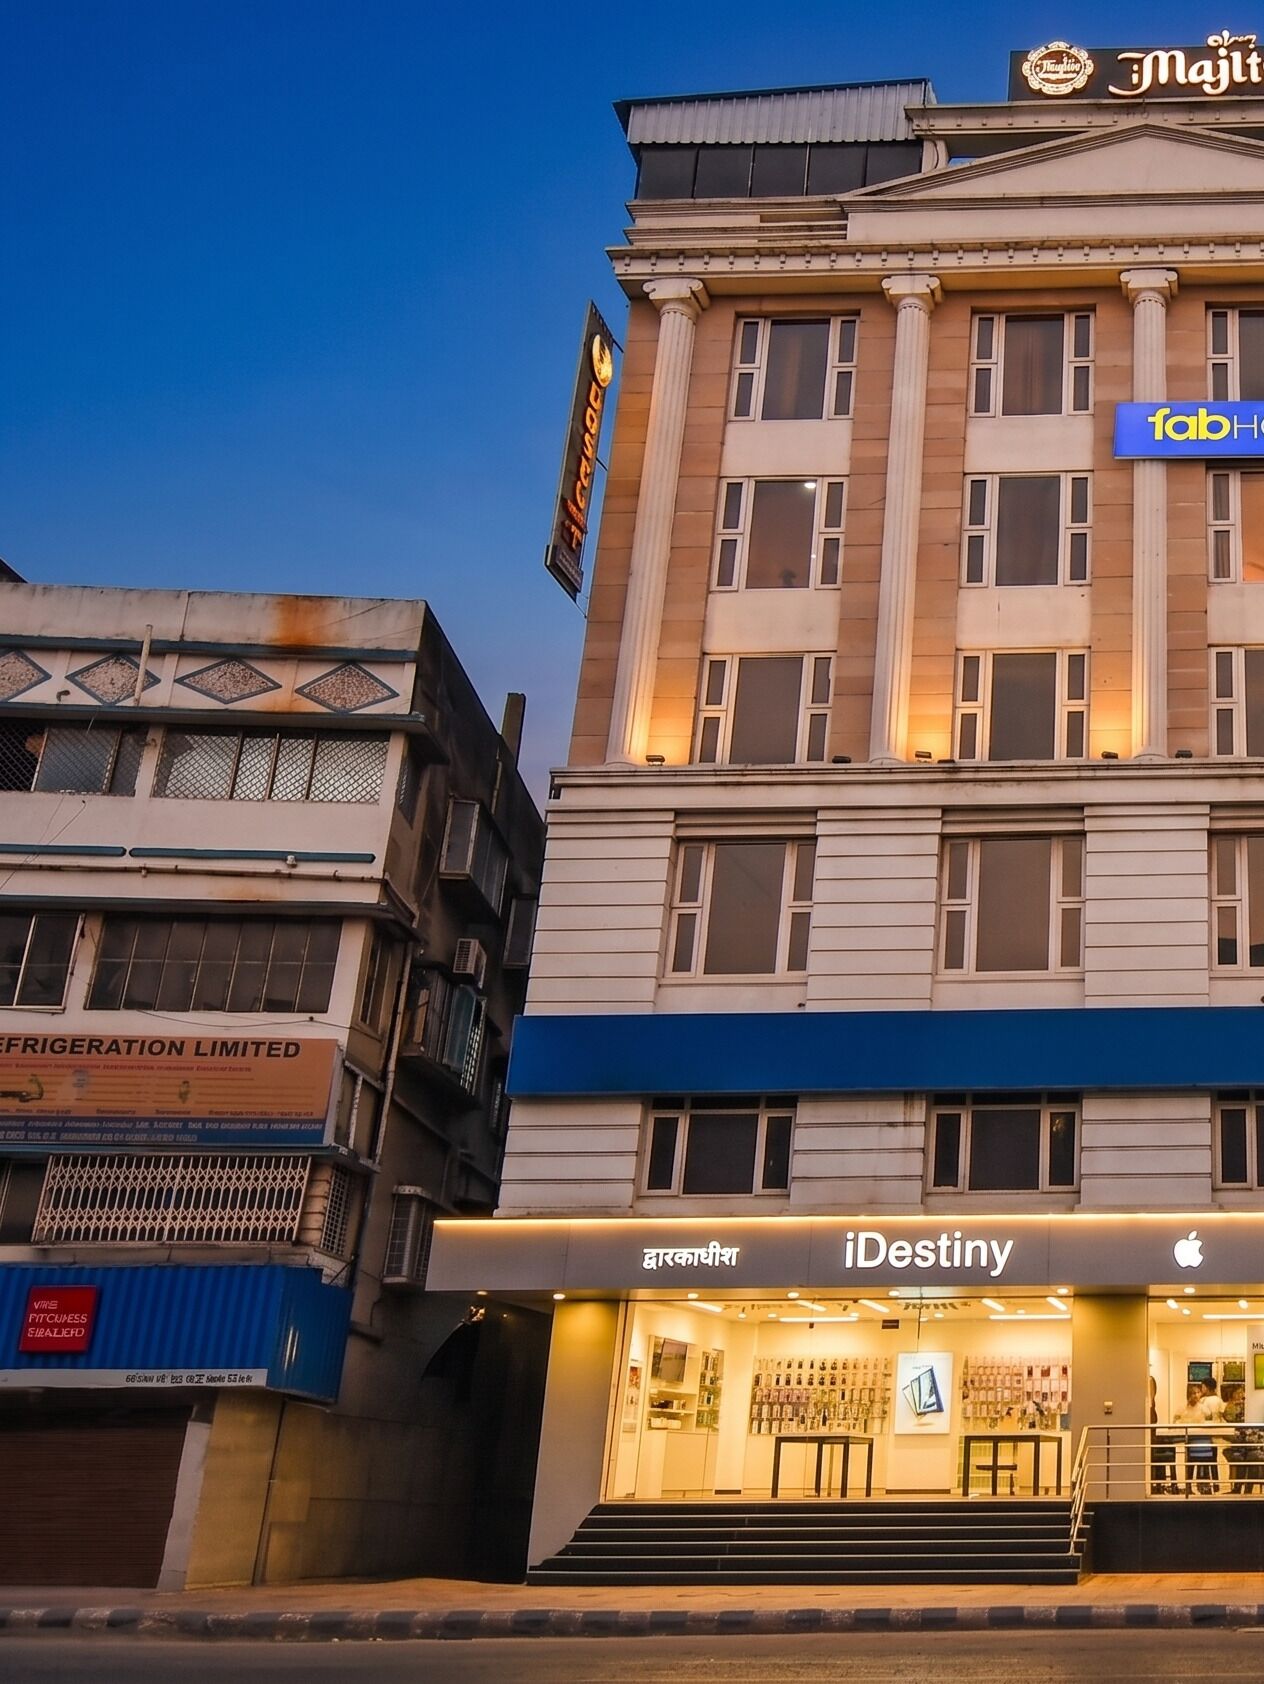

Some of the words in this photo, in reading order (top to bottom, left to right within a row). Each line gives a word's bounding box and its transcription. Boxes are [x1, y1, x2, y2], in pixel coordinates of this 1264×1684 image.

[194, 1040, 301, 1057] LIMITED
[642, 1241, 740, 1270] द्वारकाधीश
[844, 1231, 1014, 1277] iDestiny
